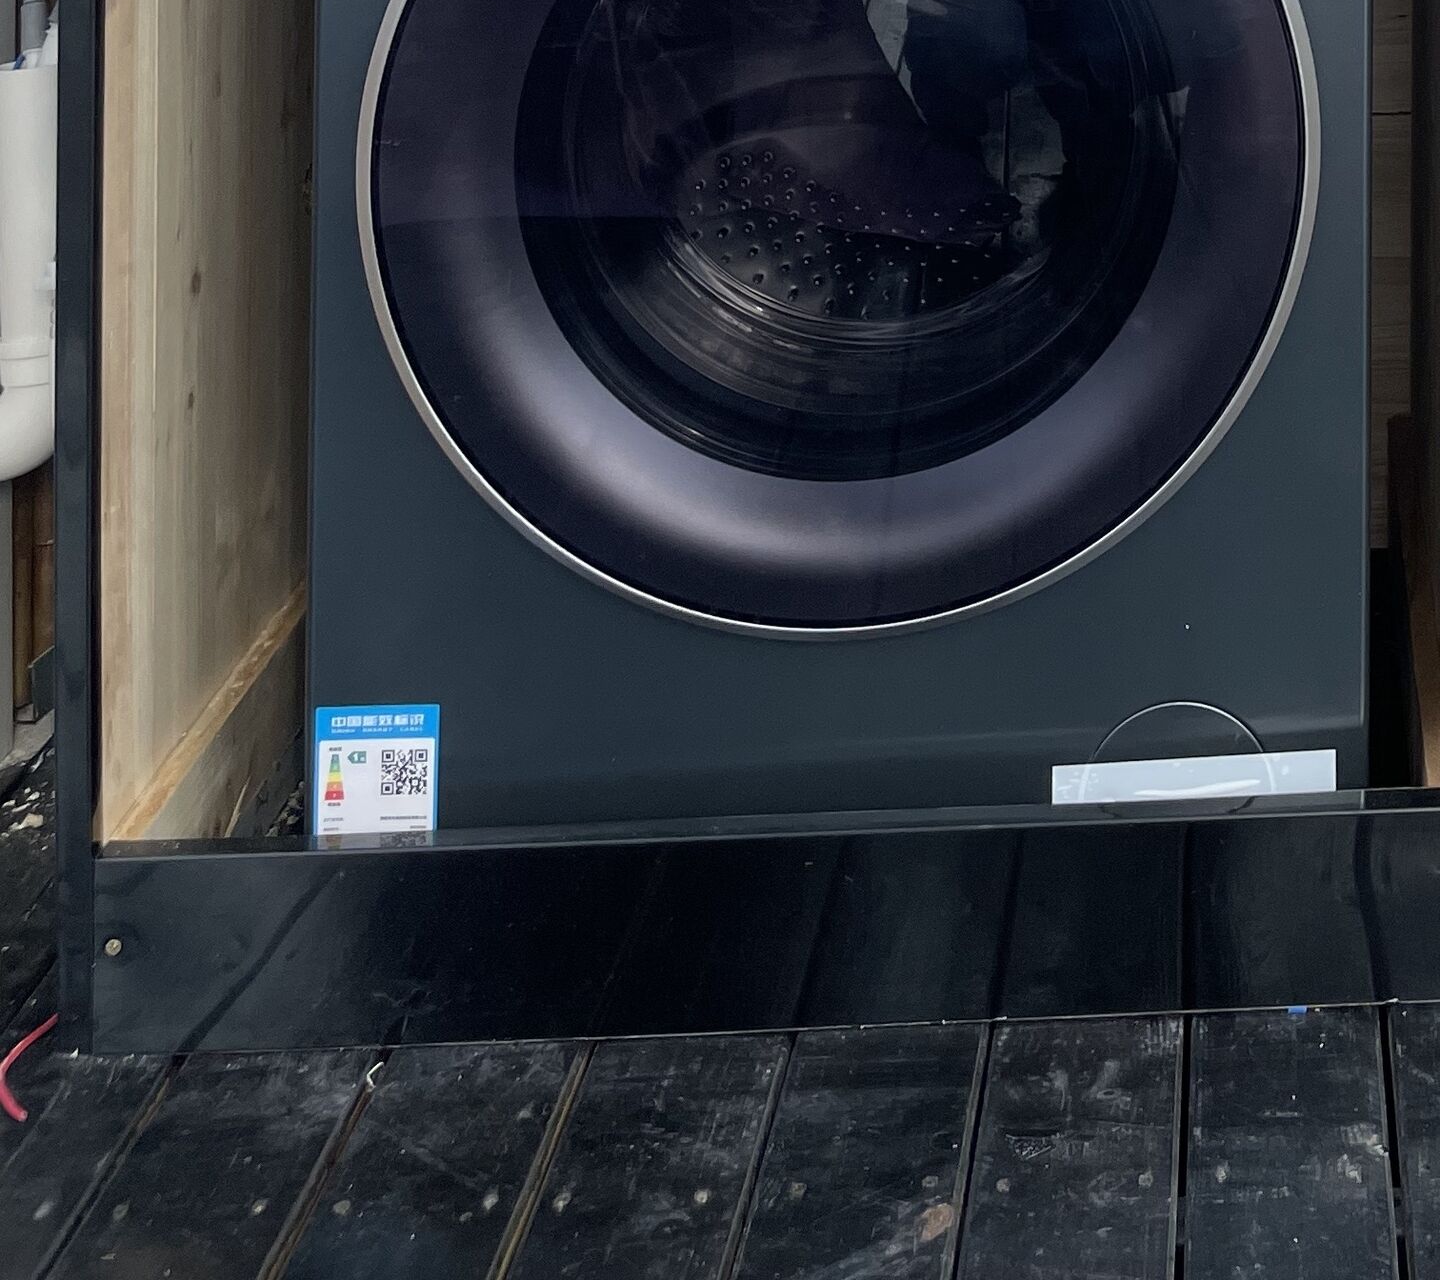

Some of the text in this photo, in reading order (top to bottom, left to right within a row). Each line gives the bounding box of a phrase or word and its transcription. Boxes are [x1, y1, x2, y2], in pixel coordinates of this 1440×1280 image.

[331, 713, 424, 727] 中国能效标识
